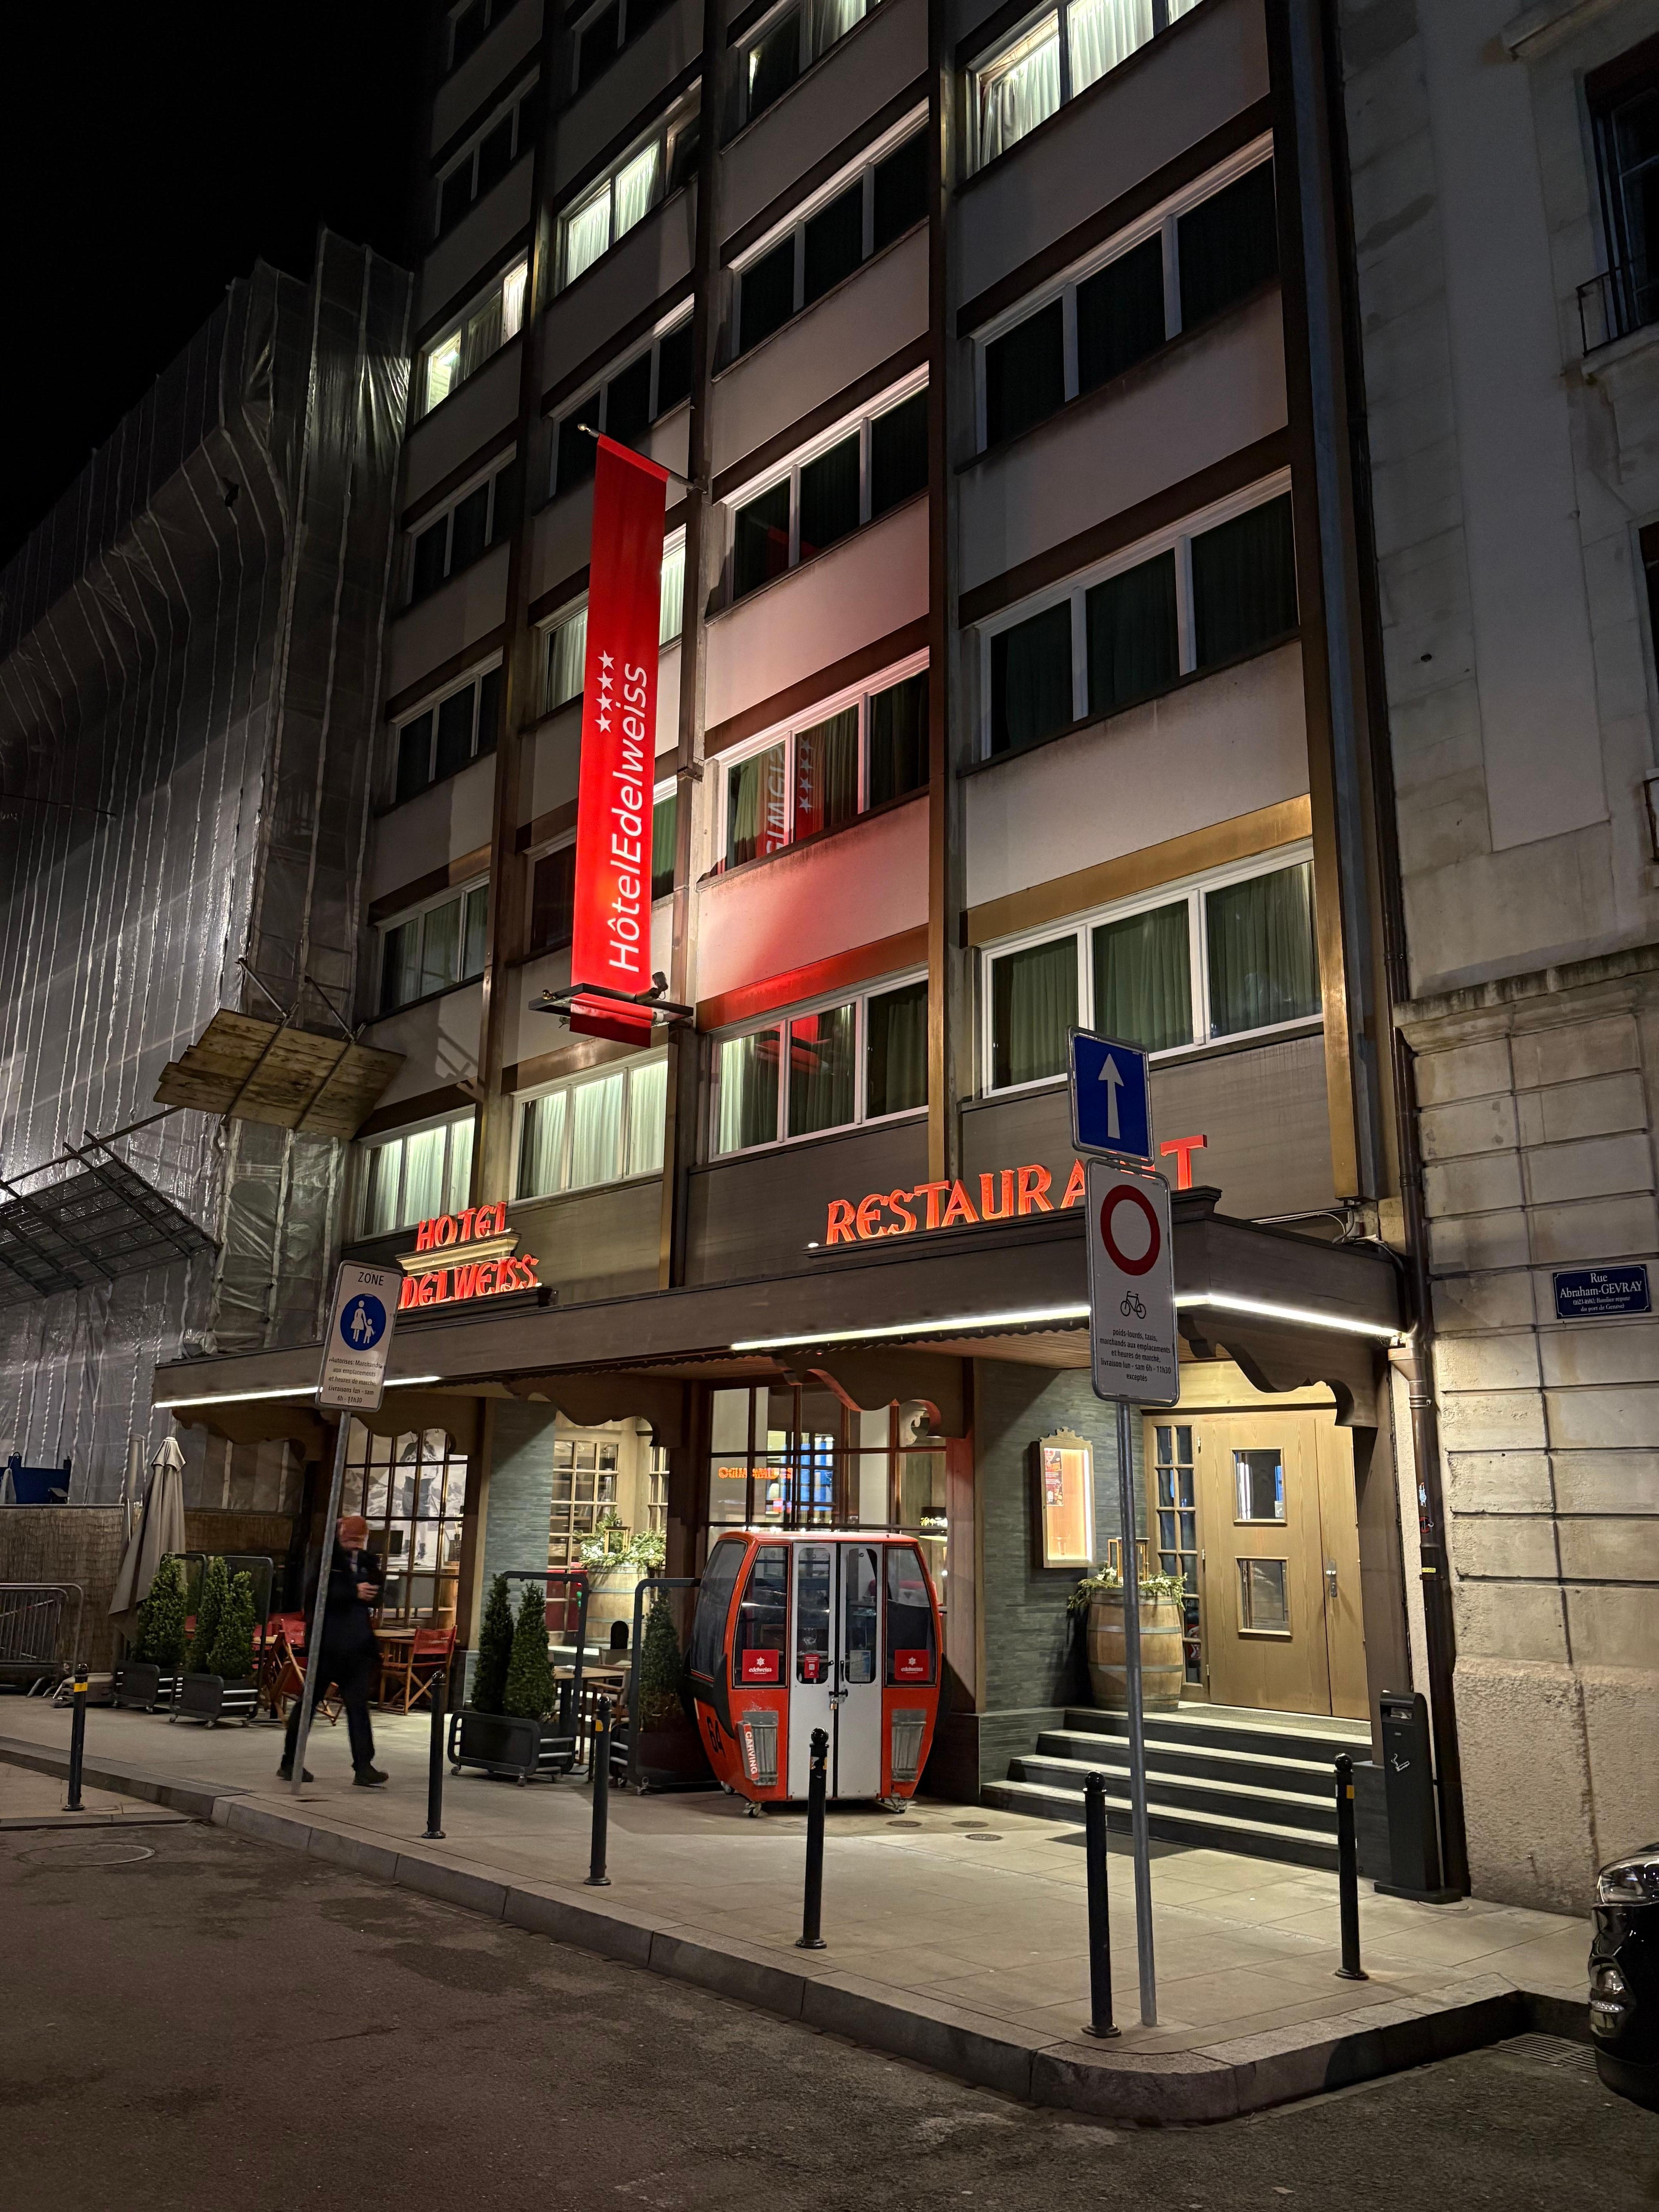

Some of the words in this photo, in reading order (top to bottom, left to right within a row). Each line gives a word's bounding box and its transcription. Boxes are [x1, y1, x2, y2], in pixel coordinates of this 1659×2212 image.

[826, 1135, 1207, 1245] RESTAURAT
[416, 1201, 508, 1252] HOTEL
[358, 1272, 385, 1286] ZONE
[398, 1254, 539, 1310] DELWEISS
[1590, 1273, 1608, 1283] Rue
[1560, 1281, 1642, 1298] Abraham-GEVRAY
[1113, 1329, 1144, 1340] poids-lourds,
[1145, 1333, 1158, 1342] taxis,
[1100, 1338, 1126, 1347] marchands
[1137, 1343, 1171, 1353] emplacements
[1118, 1350, 1133, 1358] heures
[1101, 1358, 1121, 1367] livraison
[1157, 1366, 1171, 1374] 11h30
[1127, 1374, 1147, 1382] exceptés
[745, 1731, 757, 1774] CARVING
